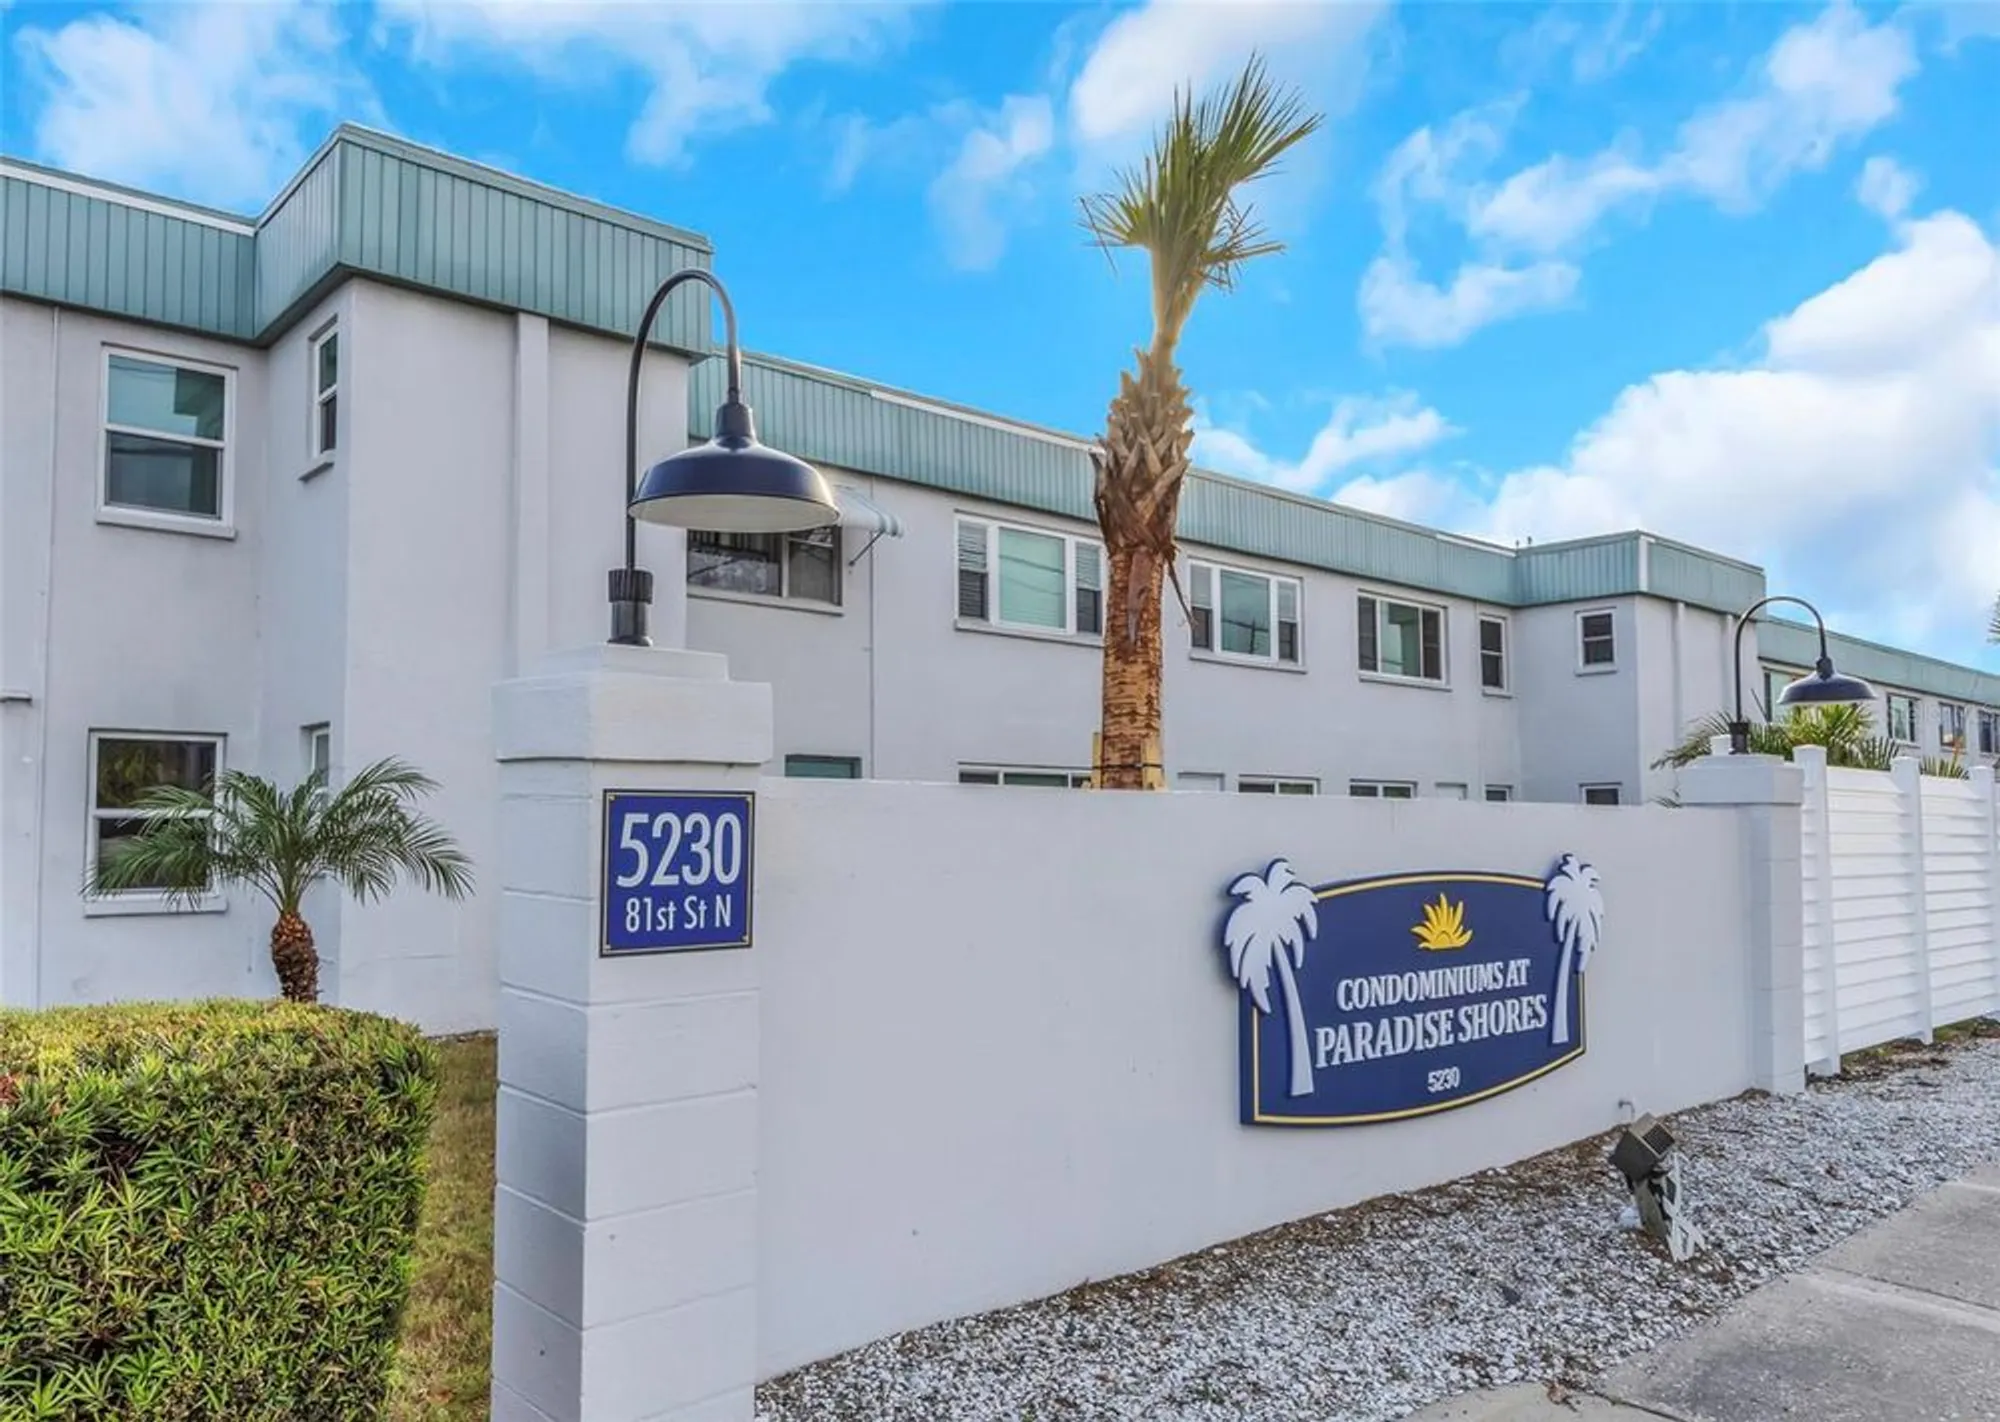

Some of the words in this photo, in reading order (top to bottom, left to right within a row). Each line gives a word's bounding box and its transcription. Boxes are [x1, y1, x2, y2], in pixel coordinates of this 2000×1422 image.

[616, 812, 742, 888] 5230
[625, 897, 677, 933] 81st
[684, 896, 708, 929] St
[714, 894, 732, 928] N
[1336, 961, 1504, 1012] CONDOMINIUMS
[1506, 958, 1531, 988] AT
[1314, 1009, 1455, 1069] PARADISE
[1457, 994, 1548, 1044] SHORES
[1427, 1066, 1461, 1093] 5230
